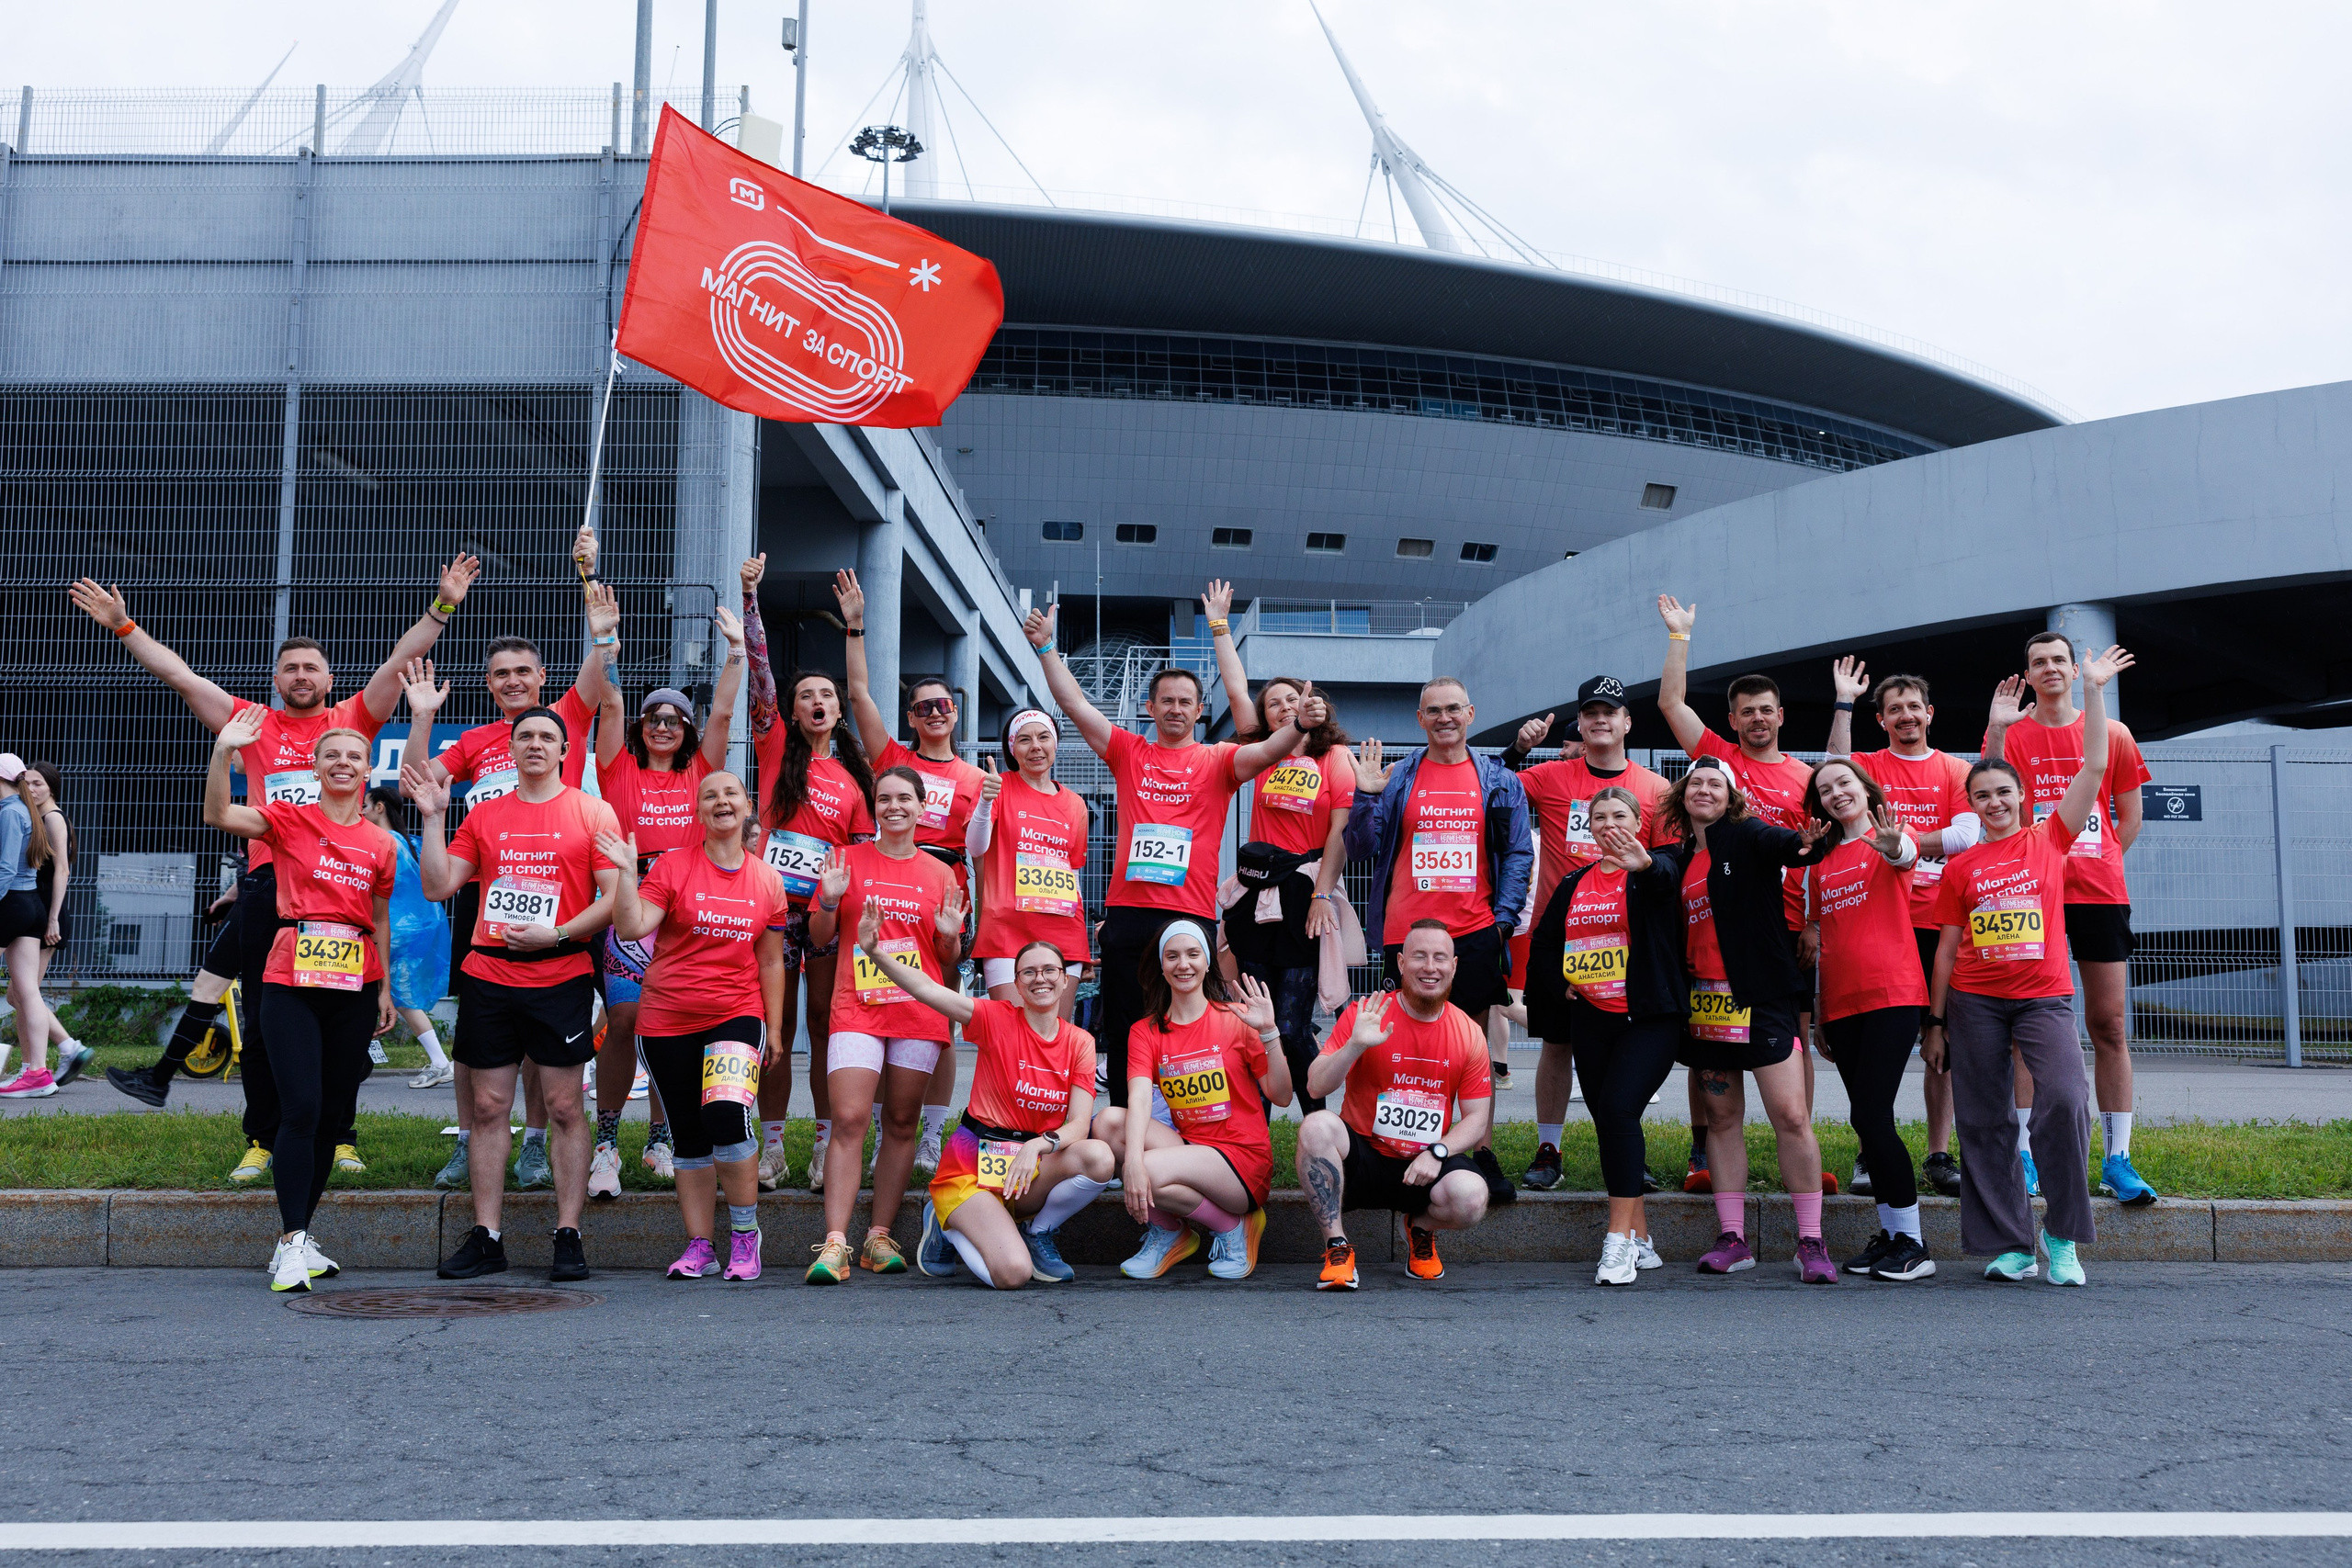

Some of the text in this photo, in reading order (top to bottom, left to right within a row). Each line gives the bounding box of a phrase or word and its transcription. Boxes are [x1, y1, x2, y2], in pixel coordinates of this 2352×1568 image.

[700, 266, 914, 394] МАГНИТ ЗА СПОРТ
[478, 766, 492, 777] за
[1268, 768, 1320, 789] 34730
[1141, 776, 1189, 791] Магнит
[1273, 784, 1305, 794] АНАСТАСИЯ
[1152, 793, 1193, 805] спорт
[2033, 788, 2050, 797] за
[641, 802, 690, 814] Магнит
[1419, 806, 1475, 817] Магнит
[1886, 801, 1938, 812] Магнит
[638, 816, 694, 828] за спорт
[1417, 820, 1478, 831] за спорт
[1021, 827, 1069, 847] Магнит
[500, 849, 557, 862] Магнит
[1017, 841, 1069, 860] за спорт
[1134, 840, 1185, 863] 152-1
[1570, 844, 1578, 854] G
[319, 855, 372, 879] Магнит
[770, 846, 824, 874] 152-3
[1414, 851, 1473, 870] 35631
[497, 865, 559, 876] за спорт
[312, 869, 371, 891] за спорт
[1018, 867, 1075, 891] 33655
[1420, 879, 1429, 889] G
[1976, 868, 2030, 893] Магнит
[1821, 880, 1865, 901] Магнит
[1996, 879, 2039, 897] спорт
[488, 890, 554, 917] 33881
[865, 894, 921, 911] Магнит
[1022, 898, 1030, 908] F
[1571, 902, 1618, 914] Магнит
[1821, 891, 1869, 915] за спорт
[697, 909, 753, 928] Магнит
[884, 910, 922, 924] спорт
[1566, 914, 1621, 927] за спорт
[1973, 911, 2041, 935] 34570
[693, 926, 753, 942] за спорт
[1996, 932, 2020, 941] АЛЁНА
[299, 939, 360, 964] 34371
[313, 960, 348, 969] СВЕТЛАНА
[1566, 949, 1625, 974] 34201
[1577, 971, 1616, 980] АНАСТАСИЯ
[864, 992, 871, 1002] F
[1692, 994, 1743, 1015] 3378
[705, 1056, 759, 1084] 26060
[721, 1076, 744, 1084] ДАРЬЯ
[1162, 1071, 1225, 1099] 33600
[1393, 1073, 1444, 1089] Магнит
[706, 1089, 712, 1100] F
[1015, 1079, 1069, 1101] Магнит
[1027, 1100, 1068, 1113] спорт
[1185, 1096, 1206, 1105] АЛИНА
[1377, 1105, 1442, 1133] 33029
[1398, 1129, 1417, 1137] ИВАН
